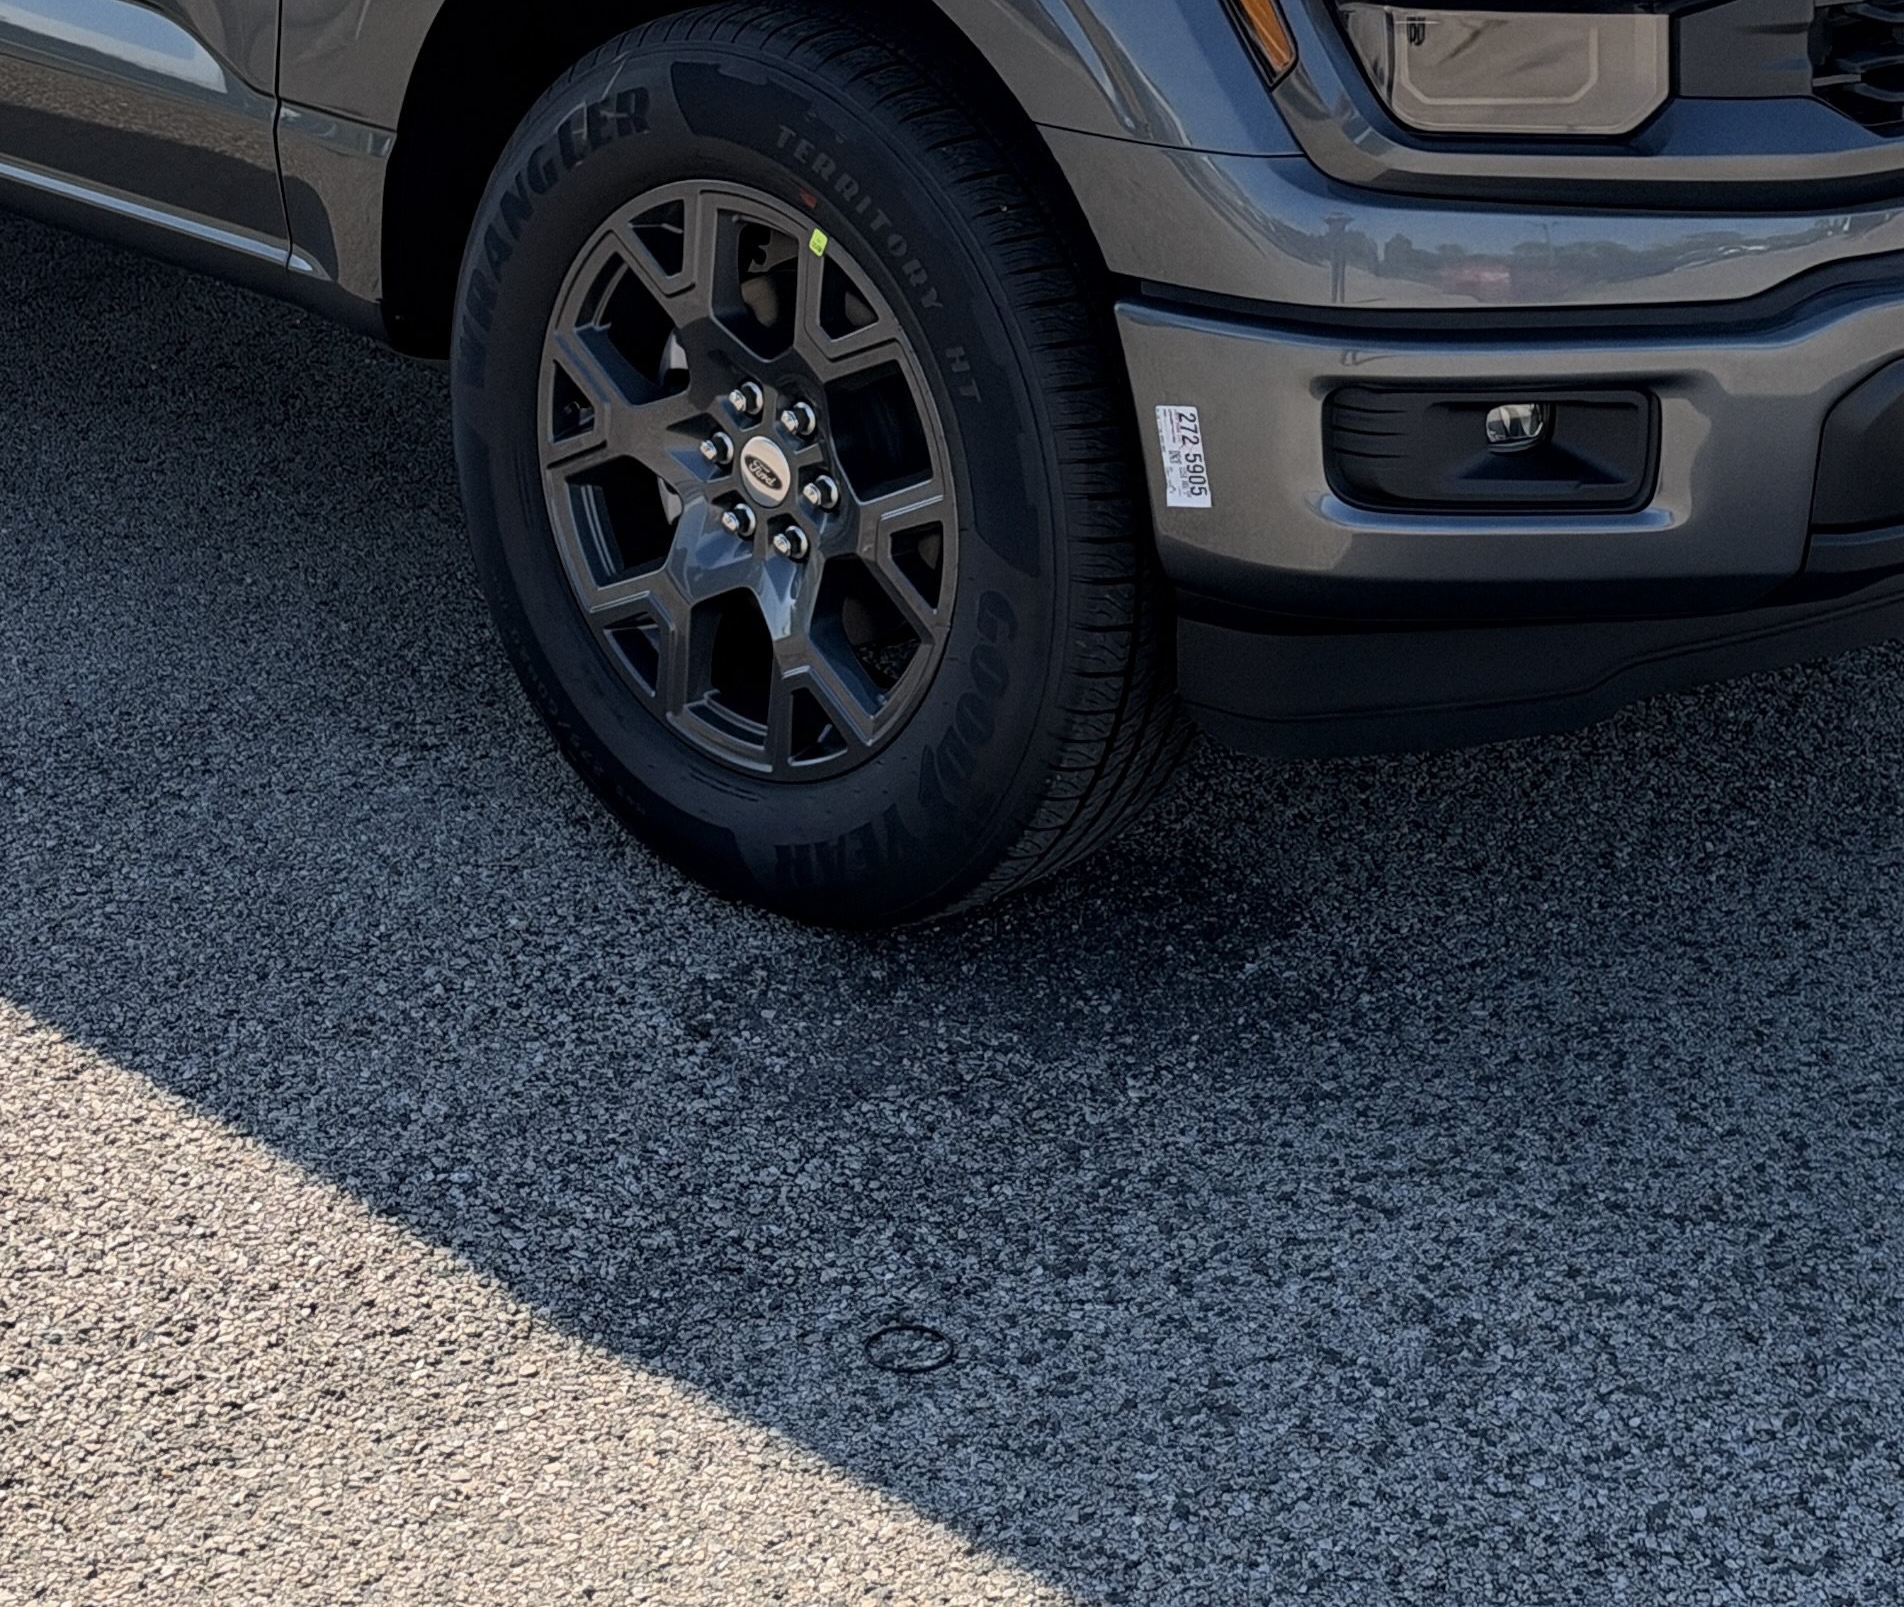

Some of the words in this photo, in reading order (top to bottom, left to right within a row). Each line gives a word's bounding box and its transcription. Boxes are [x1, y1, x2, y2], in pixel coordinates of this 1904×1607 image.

[458, 86, 650, 389] WRANGLER
[776, 124, 943, 309] TERRITORY
[945, 345, 982, 403] HT
[1178, 413, 1200, 446] 272
[749, 459, 776, 486] Ford
[1185, 452, 1208, 496] 5905
